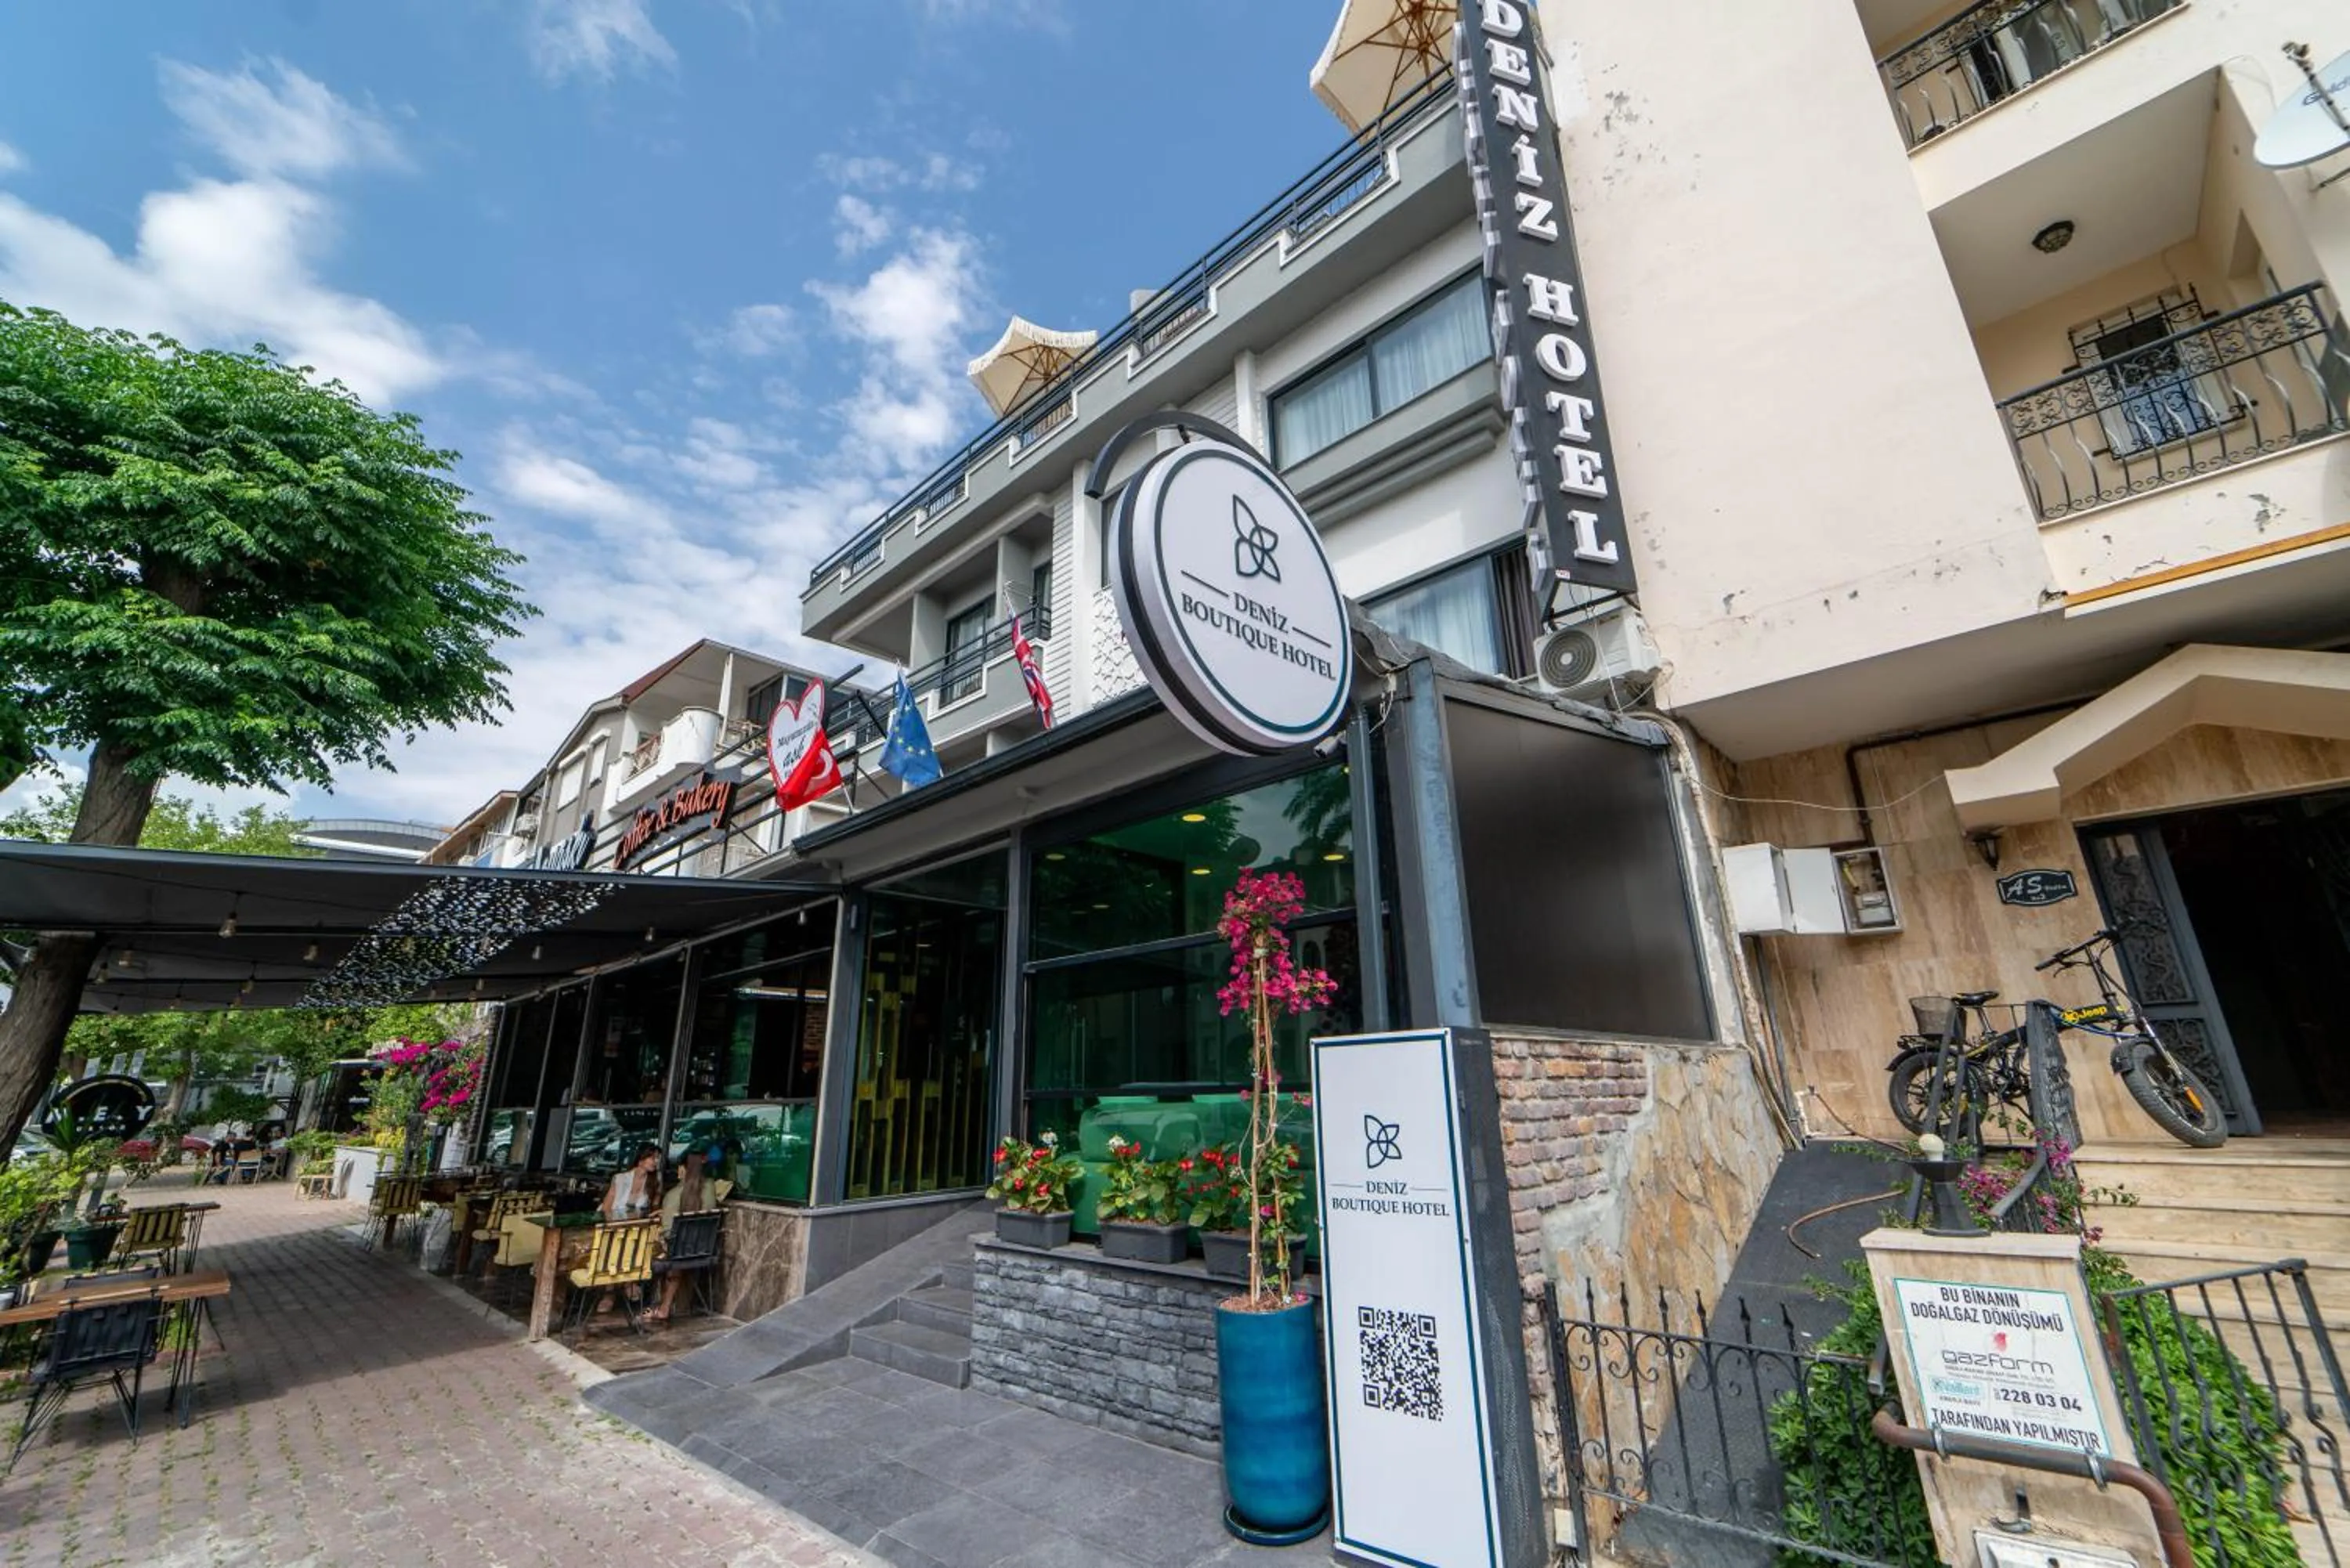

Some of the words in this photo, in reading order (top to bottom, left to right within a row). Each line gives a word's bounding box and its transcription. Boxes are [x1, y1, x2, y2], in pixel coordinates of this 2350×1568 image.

[1523, 273, 1619, 565] HOTEL
[1234, 593, 1289, 633] DENİZ
[1180, 593, 1278, 655] BOUTIQUE
[1282, 640, 1336, 681] HOTEL
[1365, 1180, 1408, 1195] DENİZ
[1332, 1198, 1399, 1215] BOUTIQUE
[1401, 1201, 1449, 1216] HOTEL
[1941, 1287, 1958, 1302] BU
[2001, 1388, 2031, 1404] 228
[2035, 1393, 2055, 1407] 03
[2061, 1396, 2082, 1411] 04
[1931, 1407, 2011, 1436] TARAFINDAN
